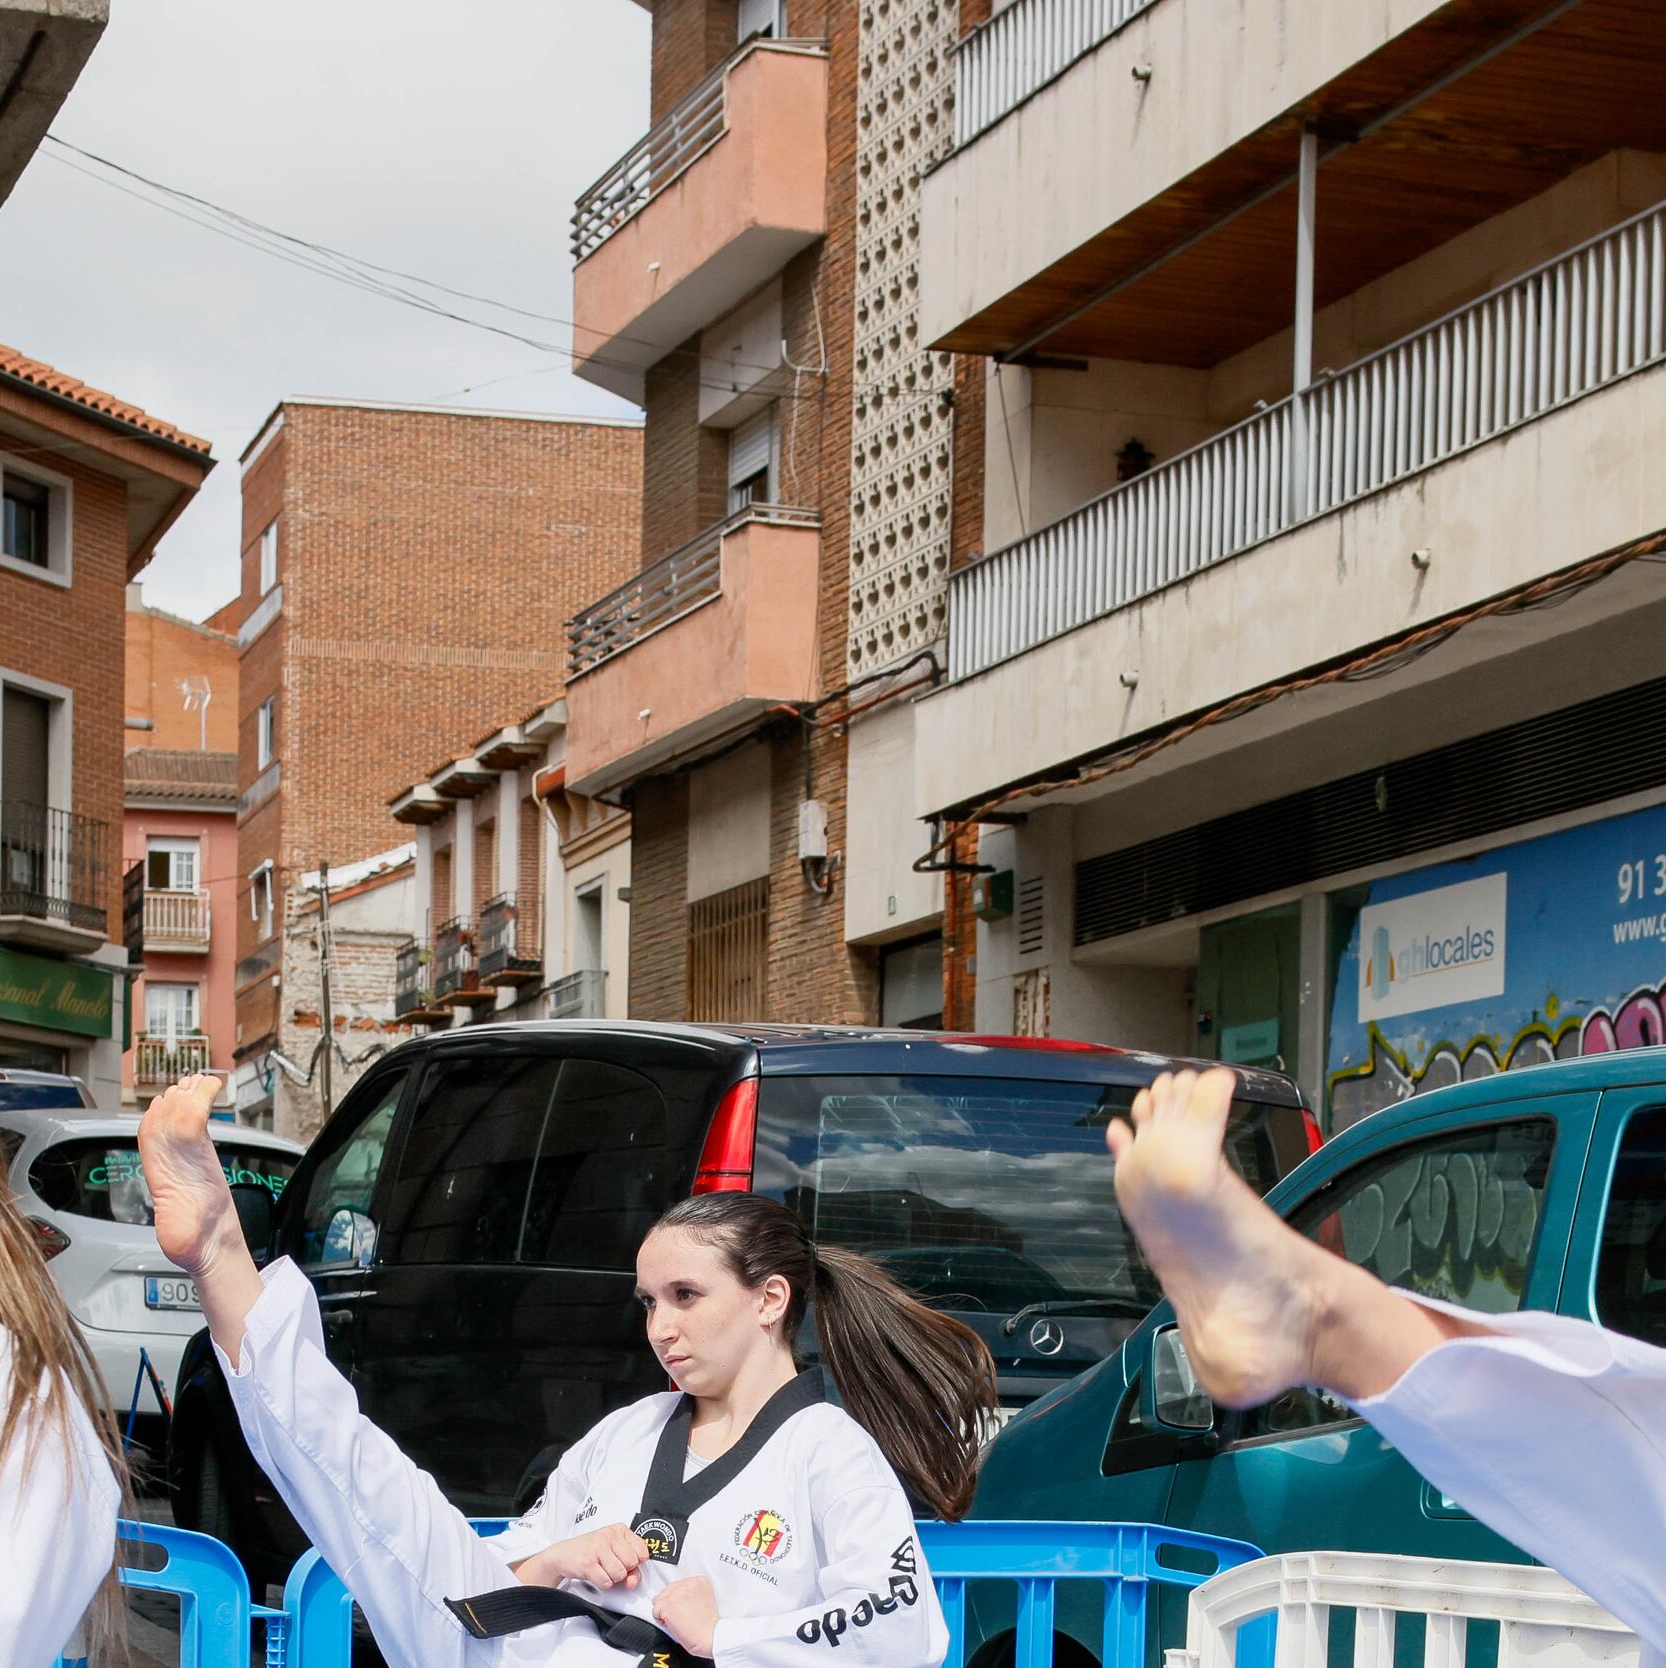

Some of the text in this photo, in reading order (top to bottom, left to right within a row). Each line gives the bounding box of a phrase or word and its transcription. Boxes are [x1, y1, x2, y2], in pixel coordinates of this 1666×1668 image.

[1618, 860, 1645, 904] 91
[1397, 925, 1495, 984] ghlocales
[636, 1521, 675, 1542] TAEKWONDO
[750, 1566, 780, 1587] OFICIAL
